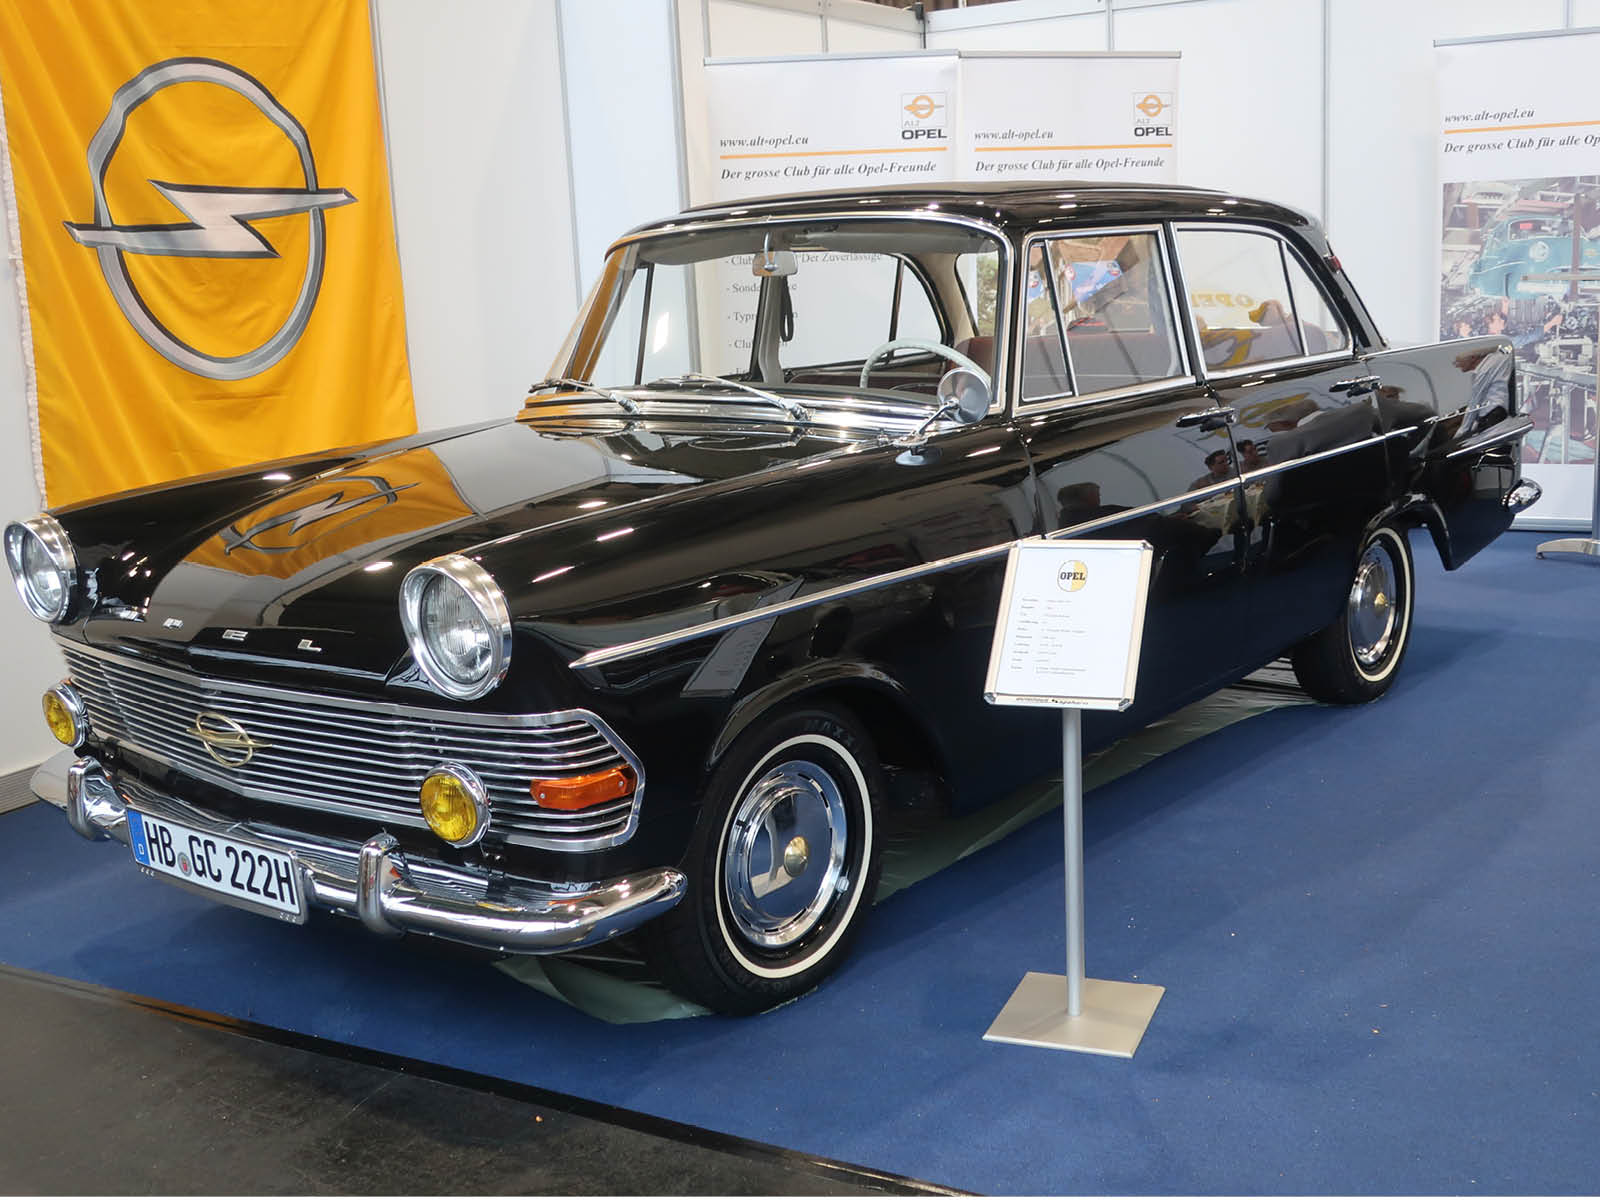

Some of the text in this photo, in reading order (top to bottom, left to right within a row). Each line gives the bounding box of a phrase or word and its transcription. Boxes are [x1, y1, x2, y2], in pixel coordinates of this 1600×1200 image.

[1445, 108, 1534, 122] www.alt-opel.eu
[901, 128, 948, 140] OPEL
[975, 128, 1054, 141] www.alt-opel.eu
[1134, 125, 1173, 137] OPEL
[720, 134, 808, 149] www.alt-opel.eu
[1444, 143, 1464, 152] Der
[1466, 143, 1504, 153] grosse
[1507, 138, 1535, 150] Club
[1536, 137, 1555, 150] für
[1559, 136, 1580, 146] alle
[720, 160, 936, 181] Der grosse Club für alle Opel-Freunde
[976, 157, 1164, 173] Der grosse Club für alle Opel-Freunde
[1060, 571, 1086, 581] OPEL
[144, 821, 296, 906] HB GC 222H
